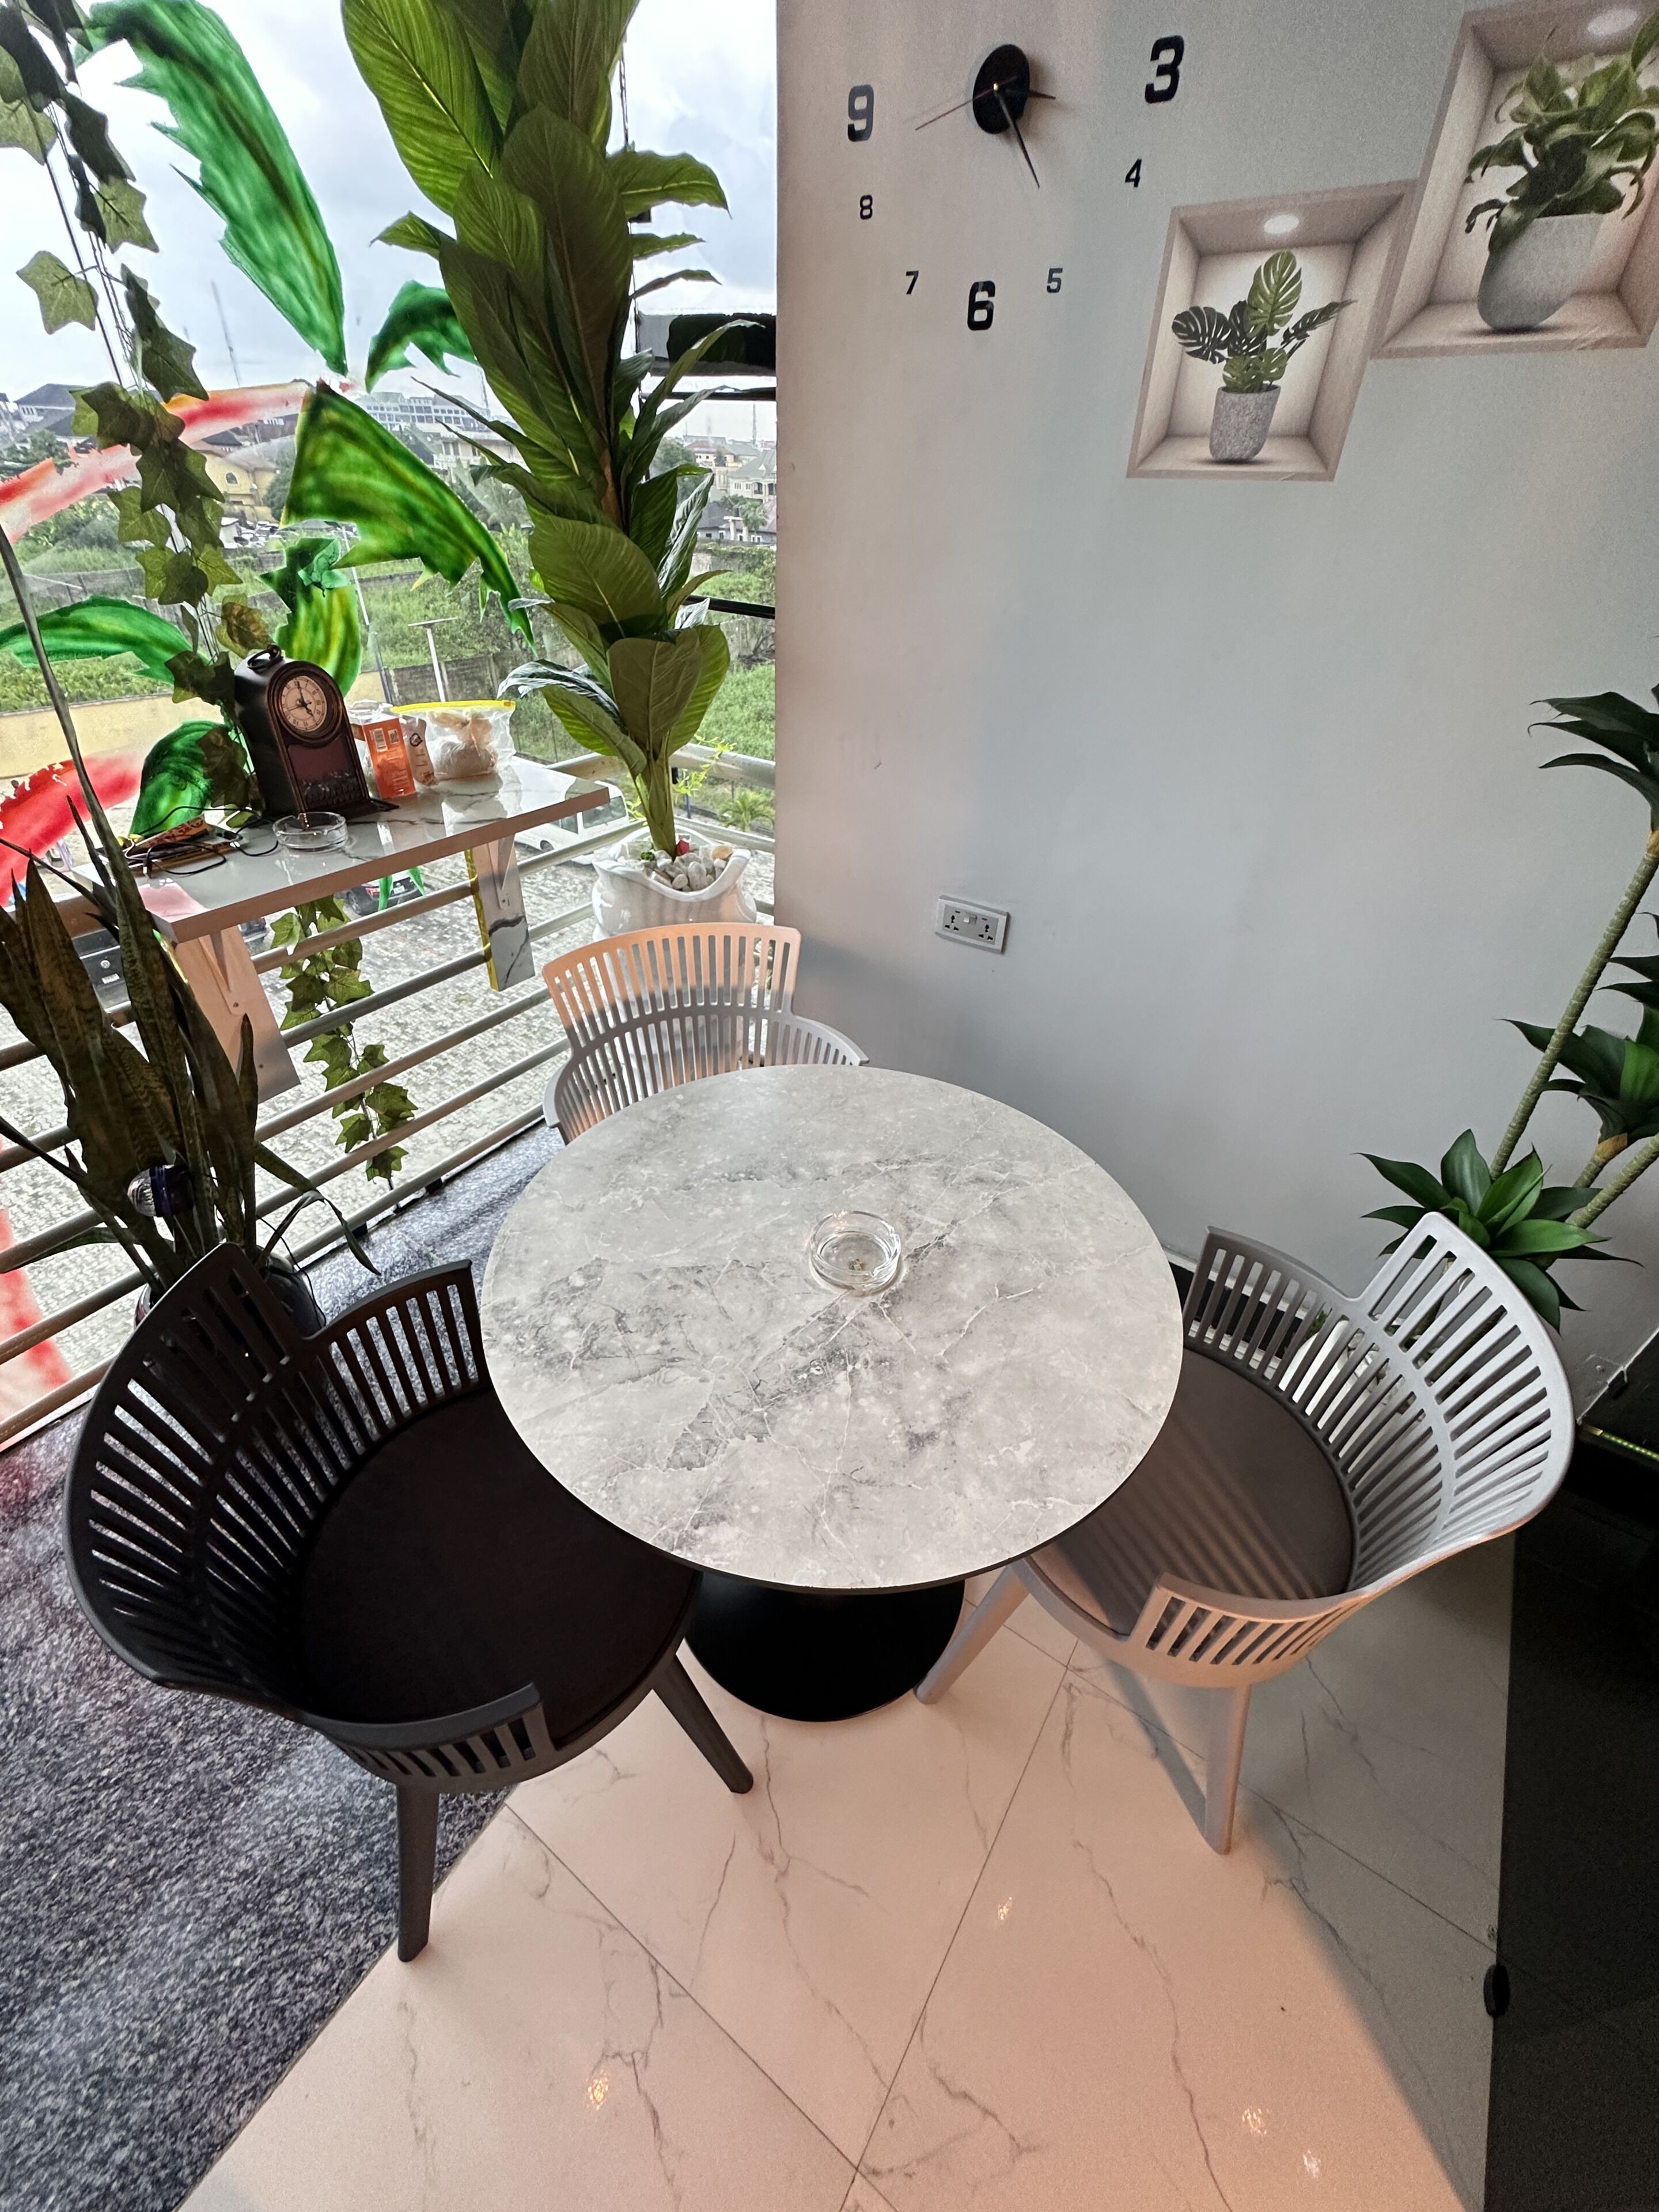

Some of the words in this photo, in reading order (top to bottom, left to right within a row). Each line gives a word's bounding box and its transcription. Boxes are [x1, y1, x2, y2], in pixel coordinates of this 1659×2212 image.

[1144, 35, 1185, 104] 3
[847, 84, 874, 143] 9
[1124, 158, 1142, 188] 4
[859, 194, 873, 221] 8
[906, 270, 919, 295] 7
[1046, 267, 1063, 294] 5
[967, 280, 996, 331] 6
